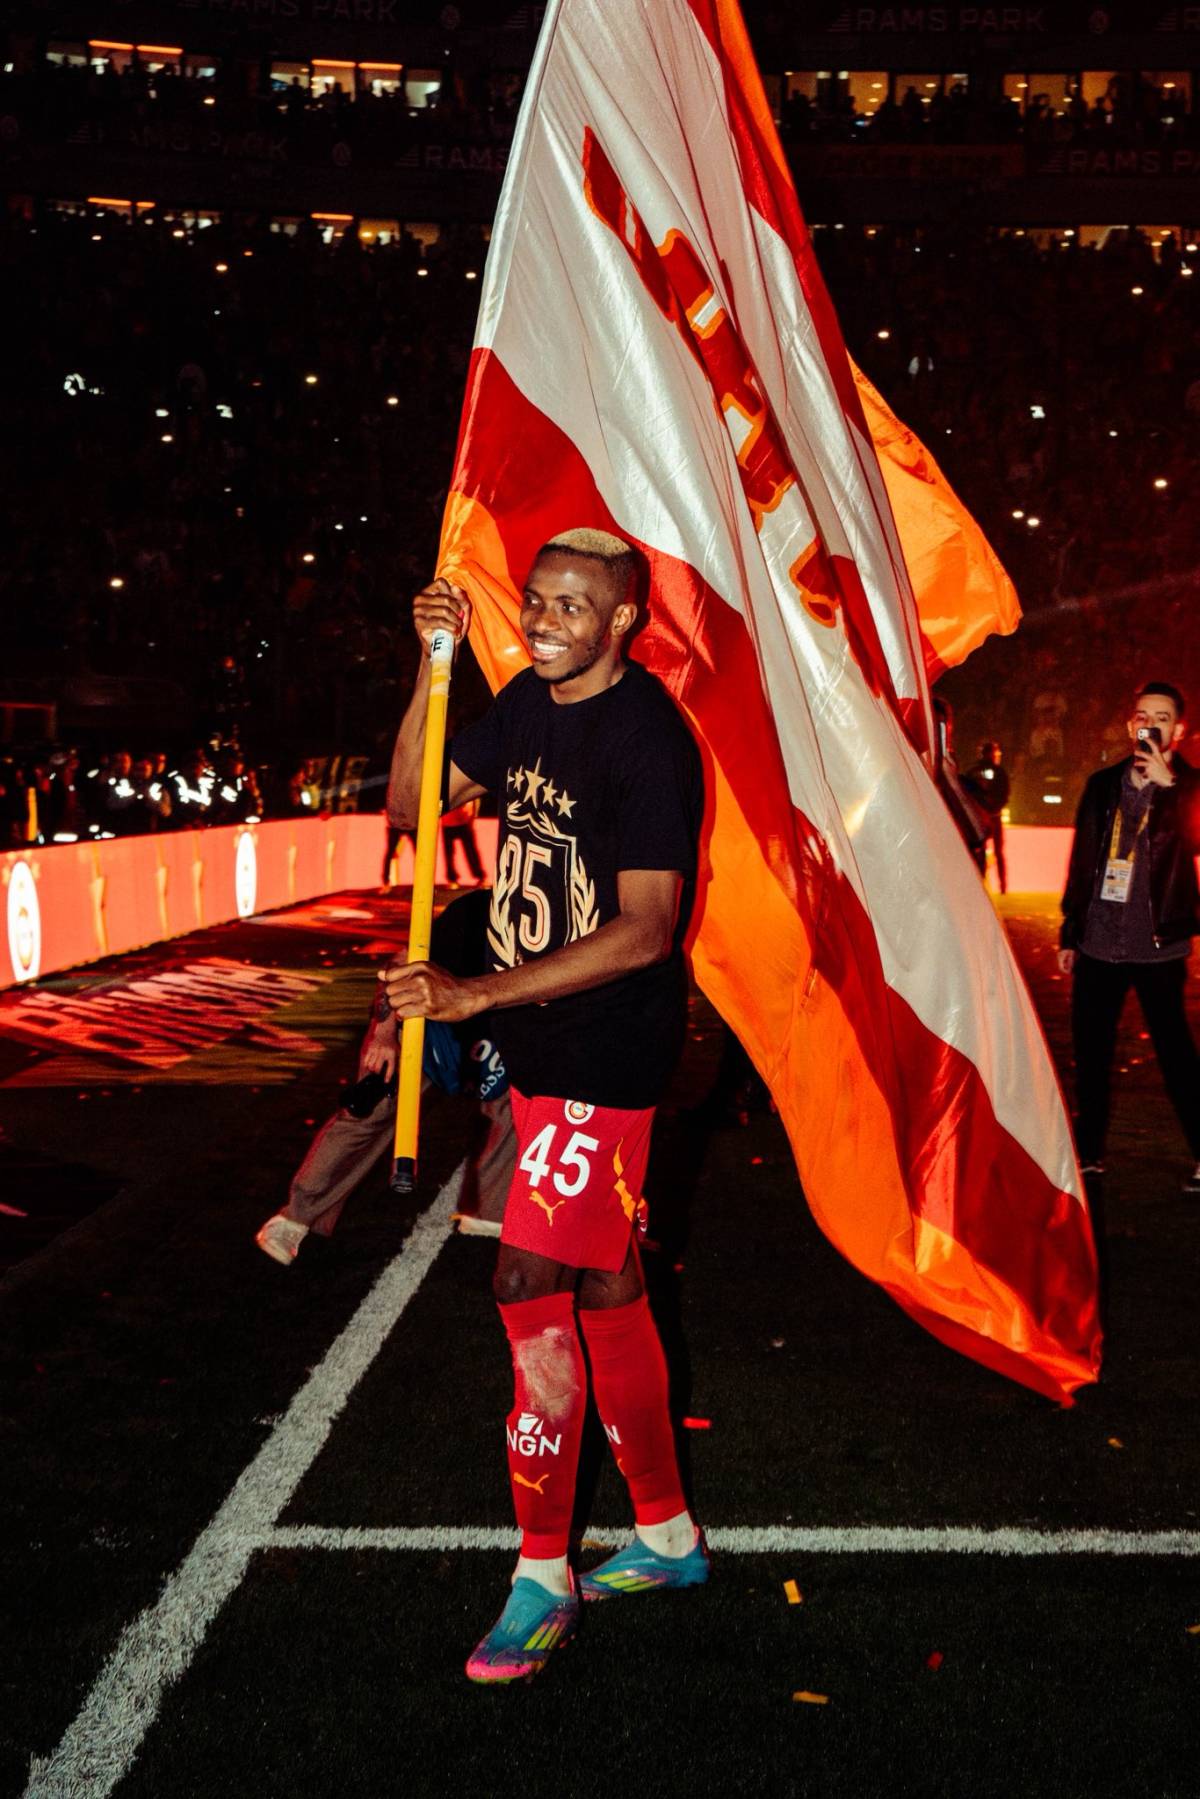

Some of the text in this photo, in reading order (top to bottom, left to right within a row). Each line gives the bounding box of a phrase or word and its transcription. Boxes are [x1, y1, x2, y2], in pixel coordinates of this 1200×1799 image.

[857, 8, 1049, 32] RAMS PARK
[1069, 150, 1161, 174] RAMS
[519, 1123, 600, 1197] 45
